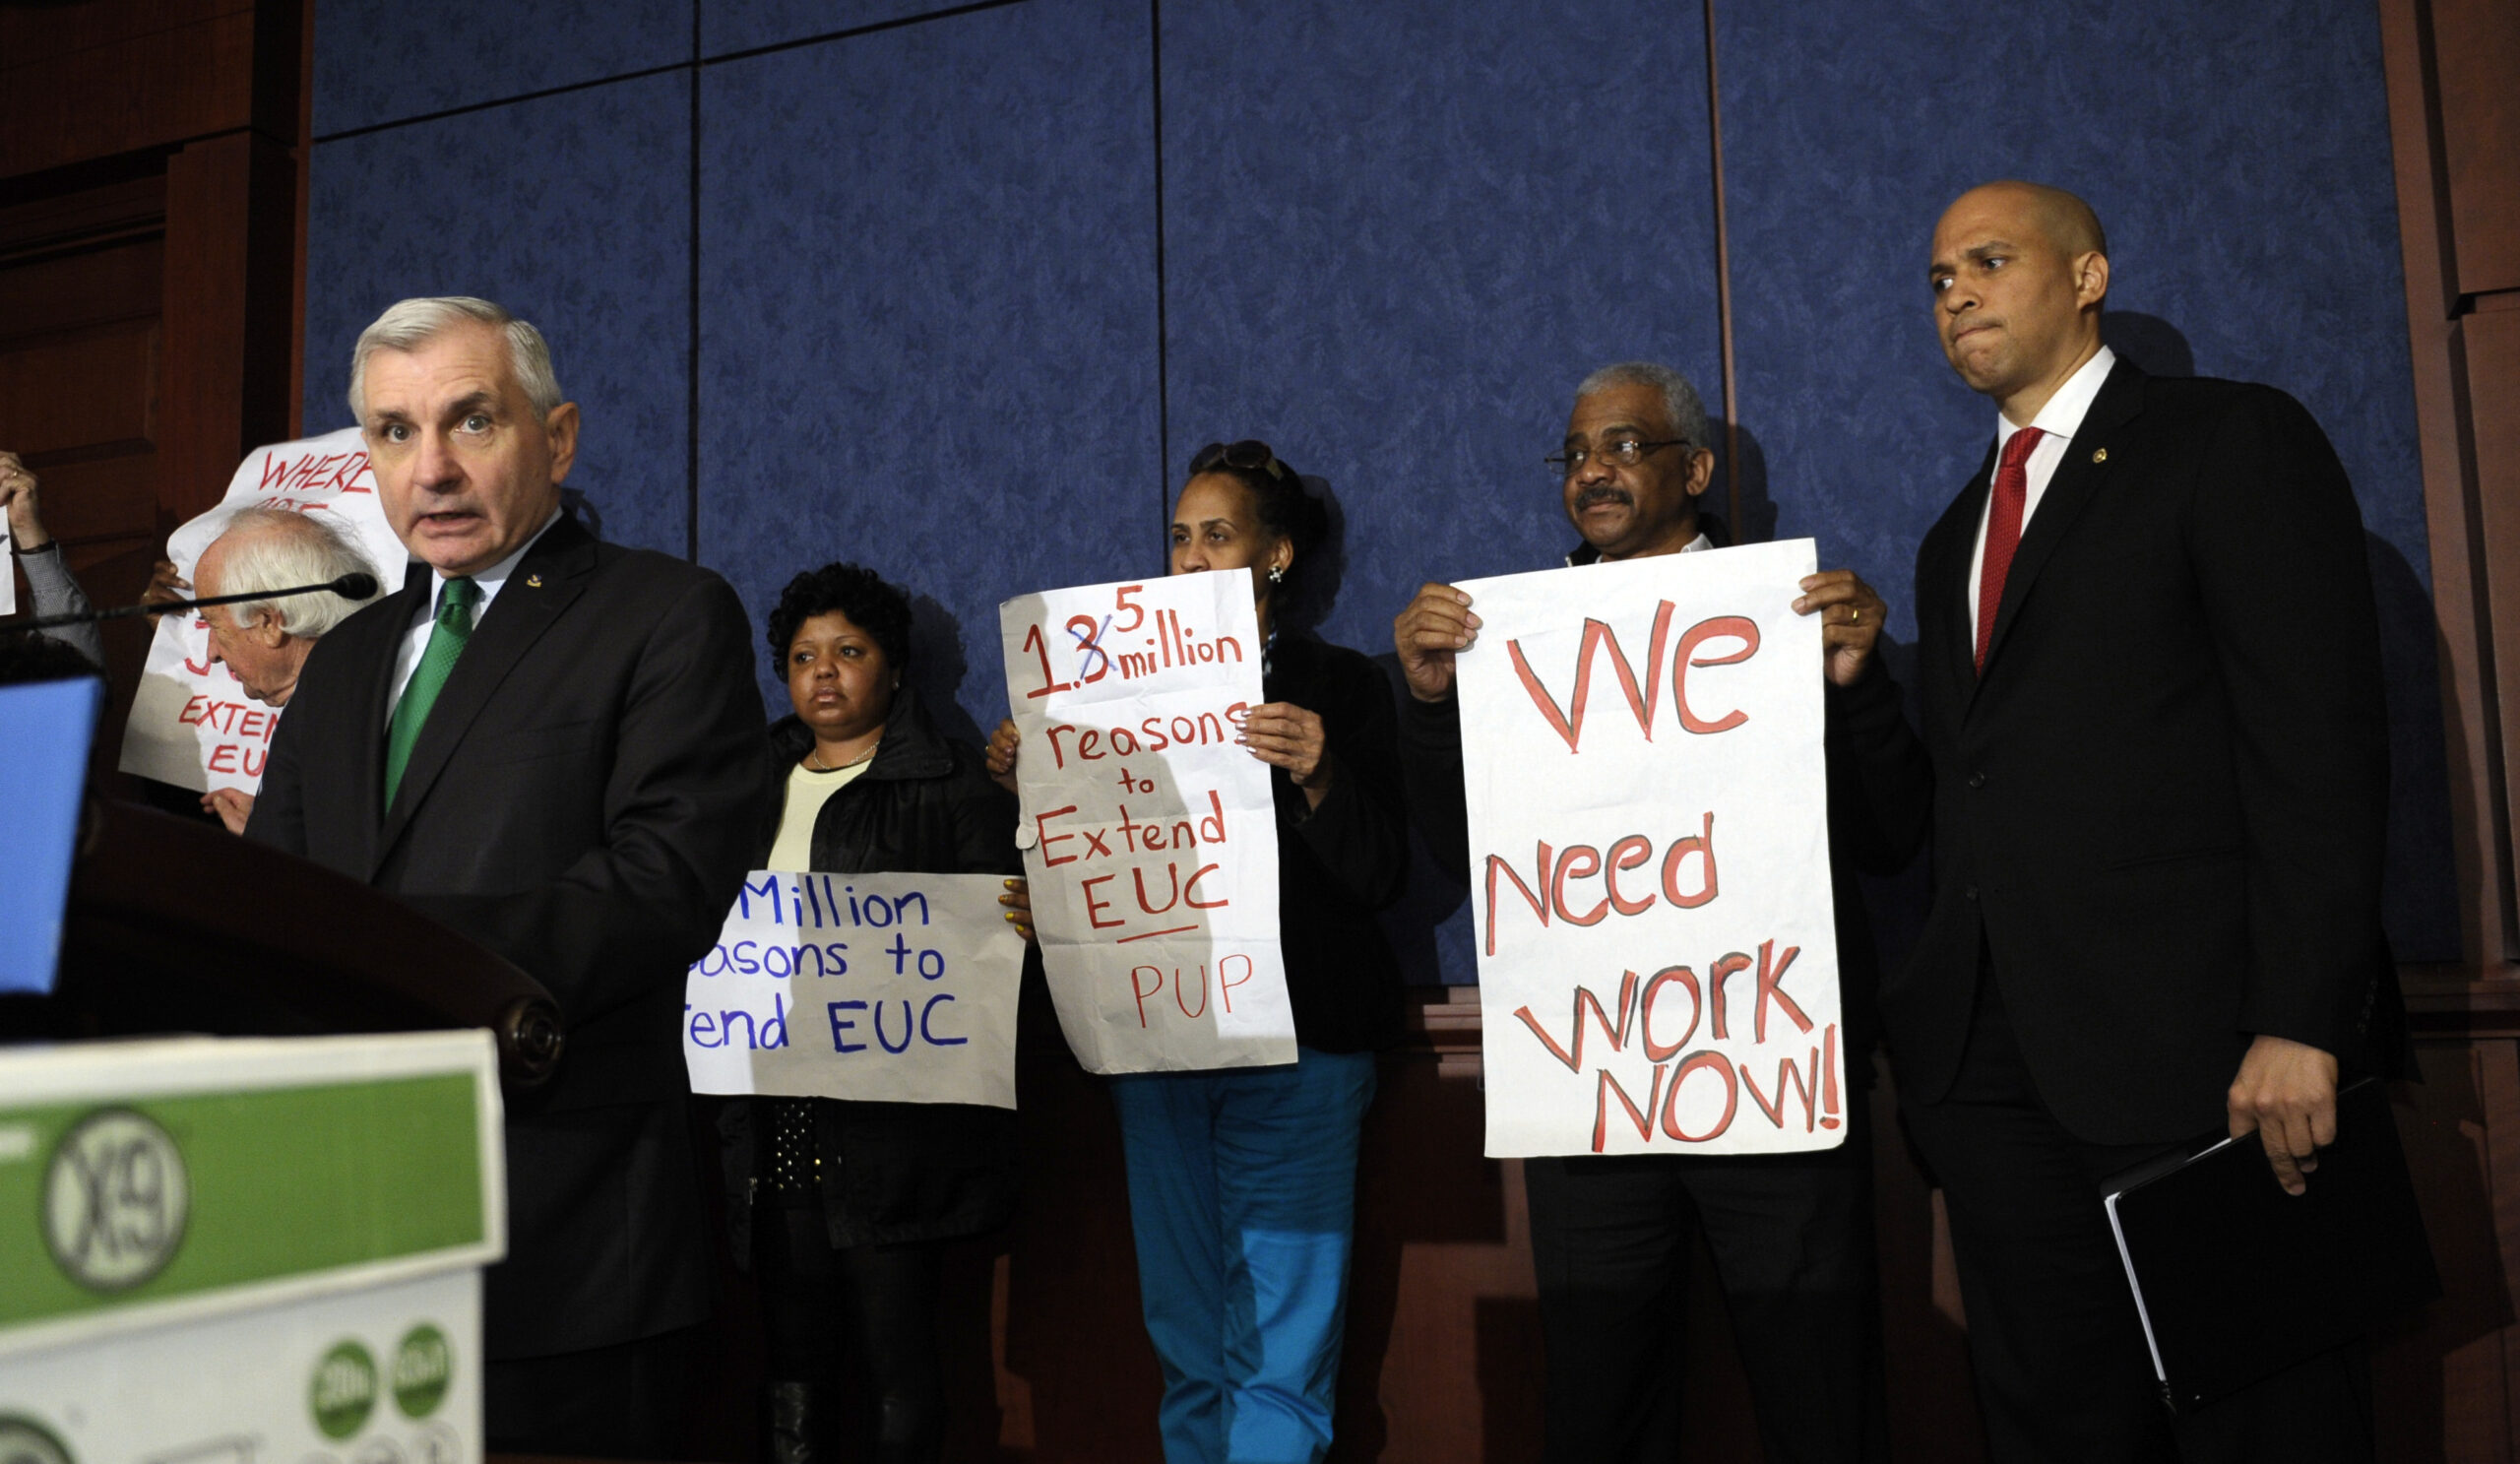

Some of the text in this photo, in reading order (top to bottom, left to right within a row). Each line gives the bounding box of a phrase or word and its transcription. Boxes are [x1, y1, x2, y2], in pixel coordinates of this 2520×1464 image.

[259, 450, 372, 493] WHERE
[1118, 608, 1242, 679] million
[1506, 599, 1761, 755] We
[1117, 768, 1155, 795] to
[1036, 789, 1227, 868] Extend
[740, 874, 930, 928] Million
[1082, 862, 1228, 929] EUC
[1484, 811, 1720, 957] Need
[689, 932, 946, 980] asons to
[686, 992, 969, 1054] end EUC
[1131, 953, 1253, 1029] PUP
